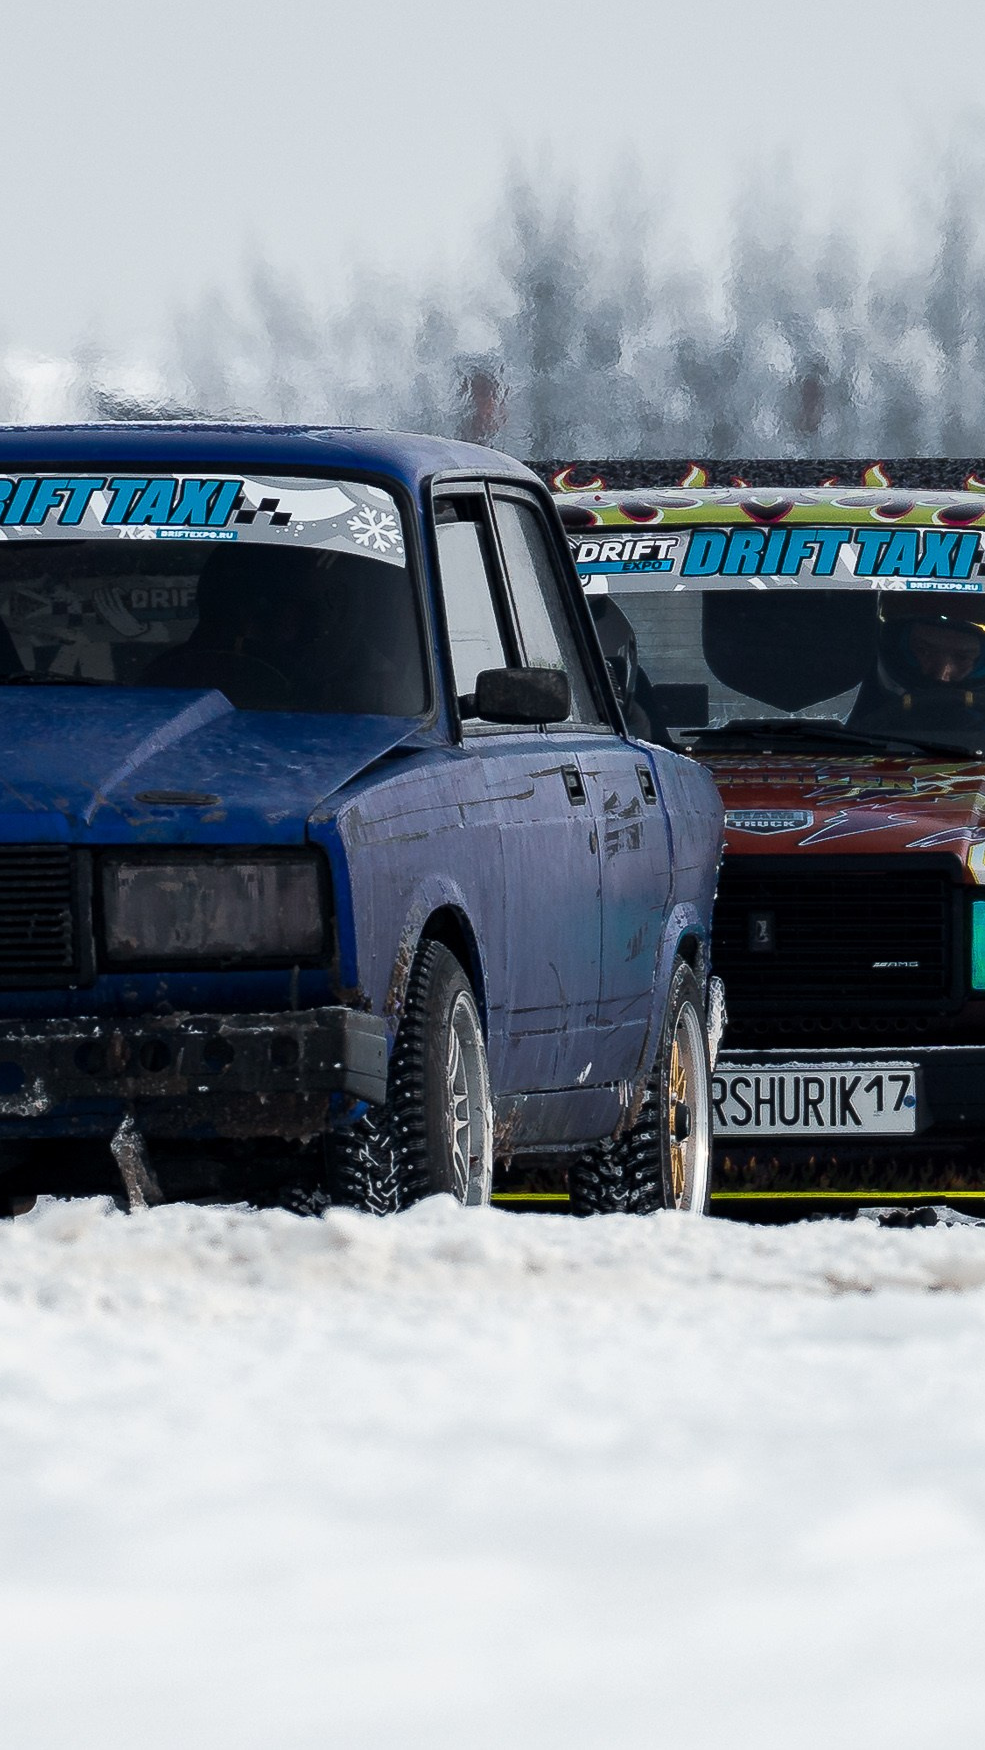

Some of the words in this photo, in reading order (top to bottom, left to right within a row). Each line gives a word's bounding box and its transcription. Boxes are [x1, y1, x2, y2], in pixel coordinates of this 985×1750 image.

[102, 479, 243, 527] TAXI
[160, 530, 234, 539] DRIFTEXPO.RU
[577, 538, 678, 563] DRIFT
[680, 529, 852, 577] DRIFT
[854, 530, 981, 579] TAXI
[621, 560, 663, 571] EXPO
[910, 582, 979, 591] DRIFTEXPO.RU
